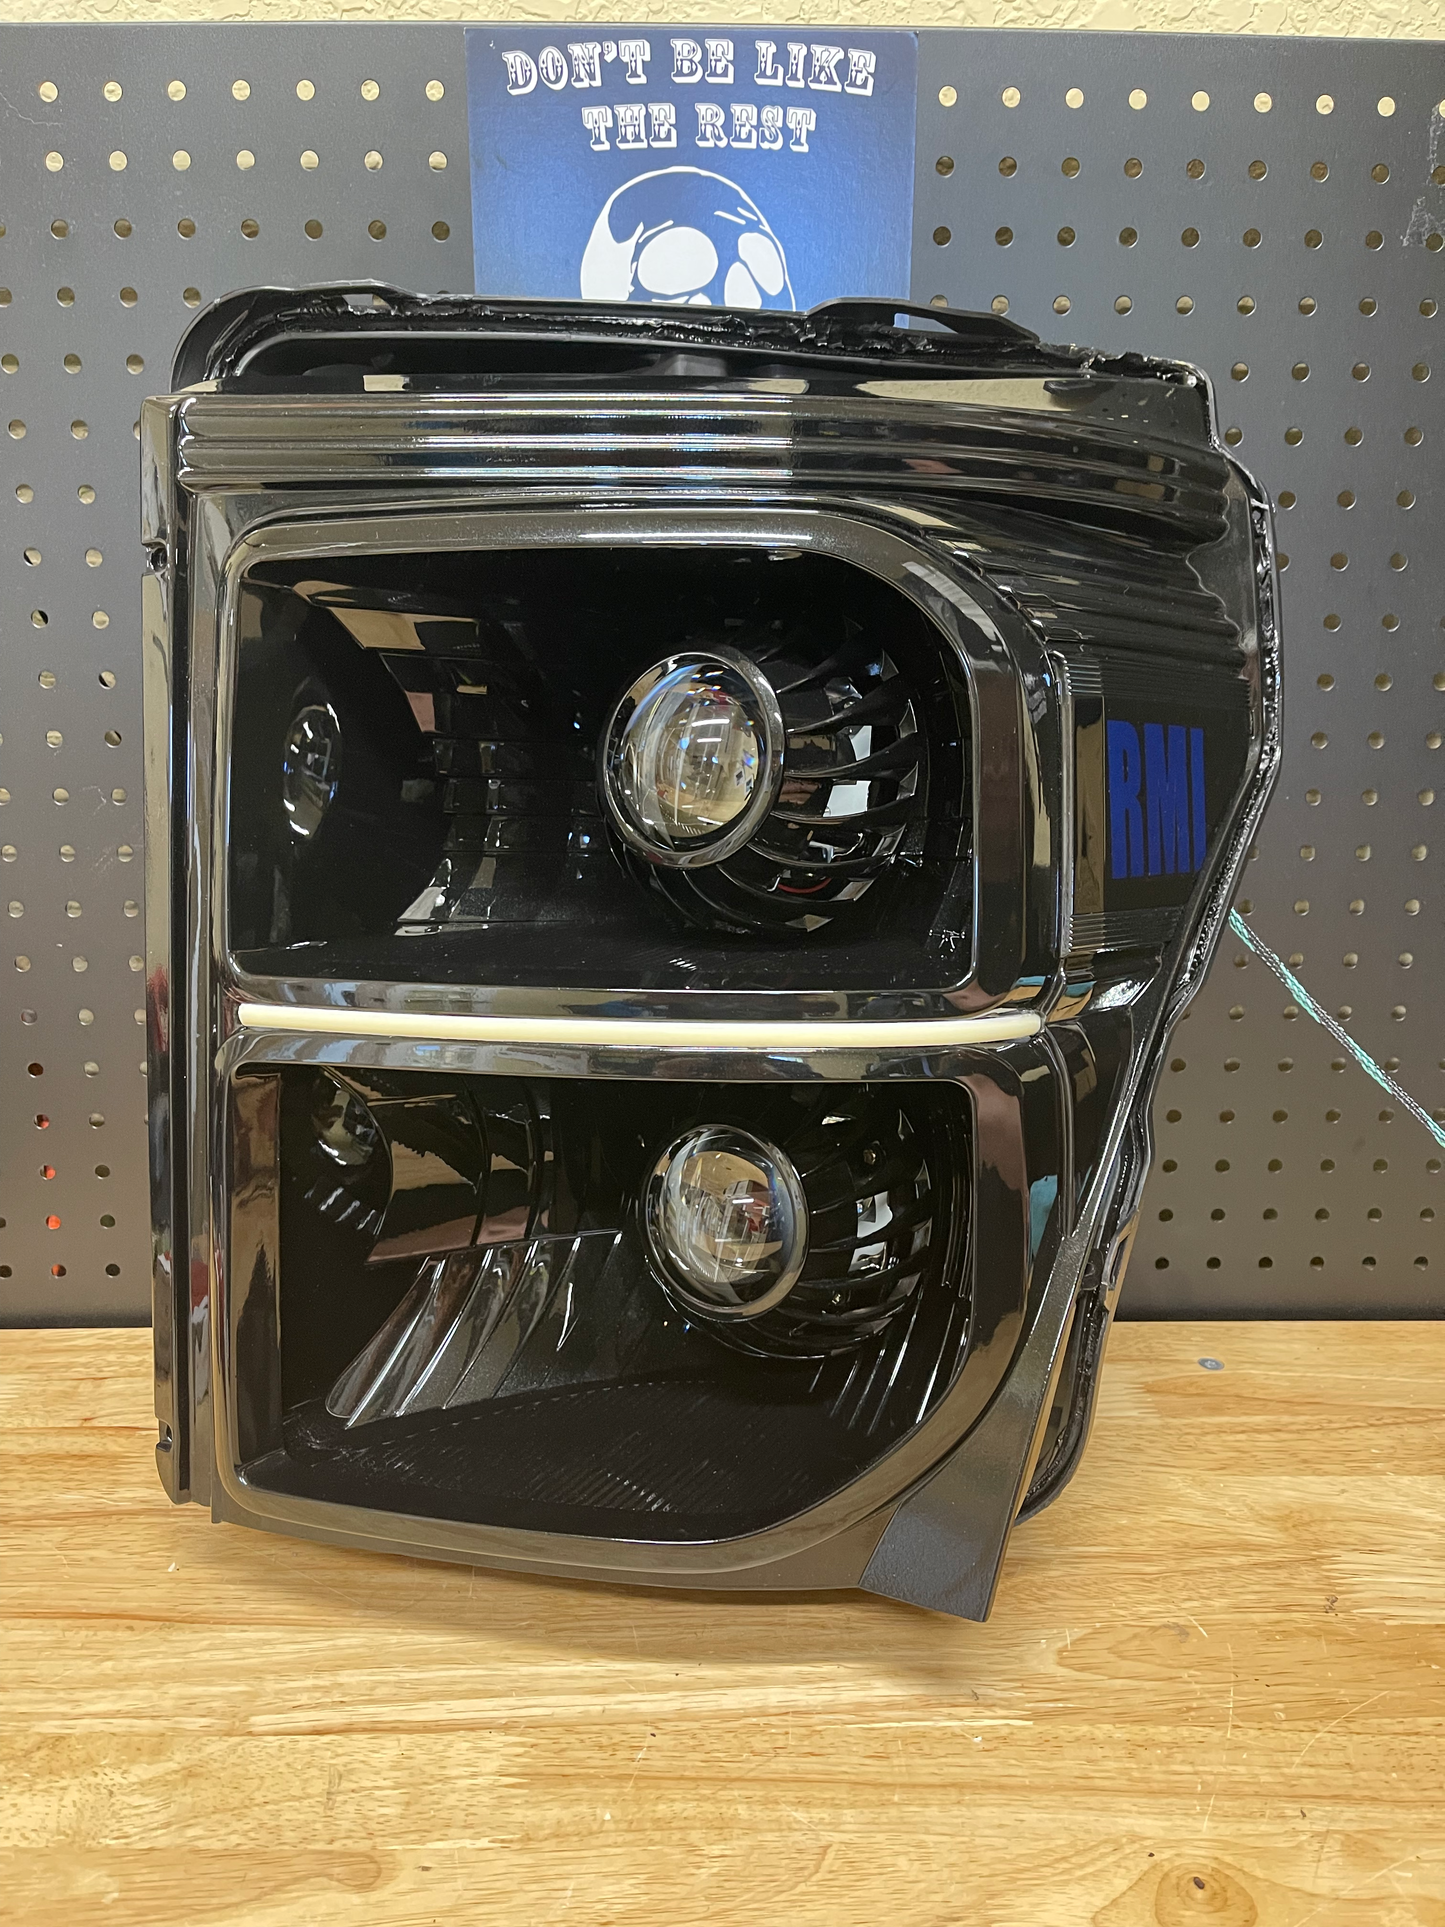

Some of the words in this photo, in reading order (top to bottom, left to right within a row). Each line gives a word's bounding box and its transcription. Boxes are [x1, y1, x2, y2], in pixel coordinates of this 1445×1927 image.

[502, 38, 651, 96] DON'T
[670, 38, 735, 84] BE
[754, 40, 876, 96] LIKE
[581, 102, 677, 151] THE
[695, 102, 817, 152] REST
[1107, 720, 1207, 879] RMI
